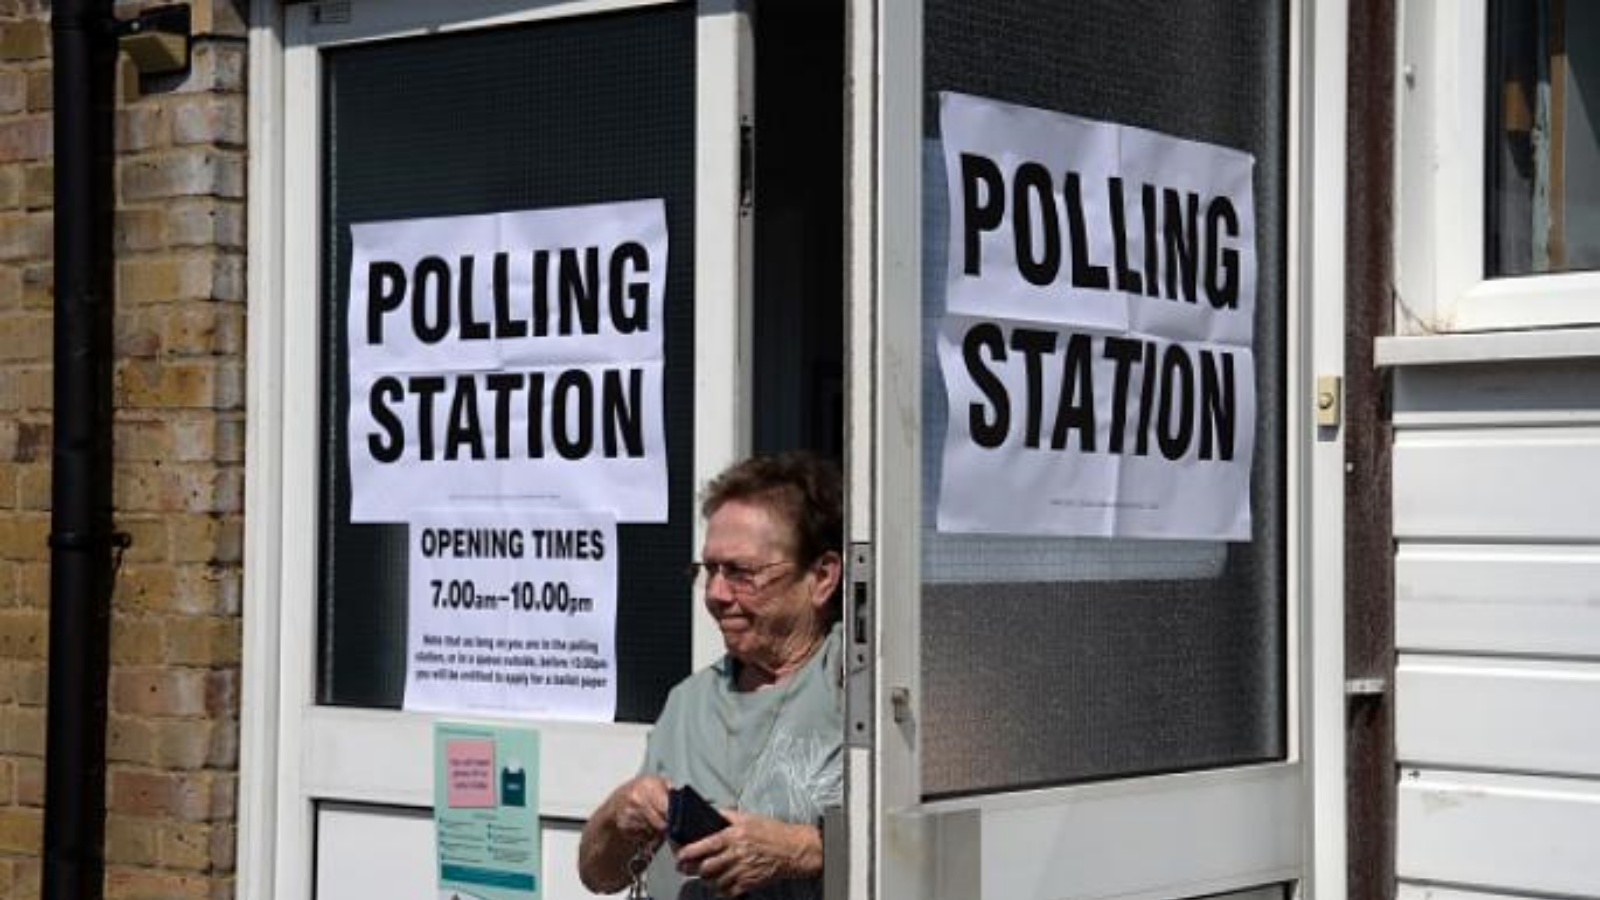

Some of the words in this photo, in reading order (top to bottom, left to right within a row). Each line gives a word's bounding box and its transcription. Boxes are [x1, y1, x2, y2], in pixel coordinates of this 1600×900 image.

[959, 151, 1240, 310] POLLING
[367, 241, 650, 345] POLLING
[367, 368, 645, 463] STATION
[961, 322, 1235, 462] STATION
[421, 528, 525, 558] OPENING
[531, 529, 605, 560] TIMES
